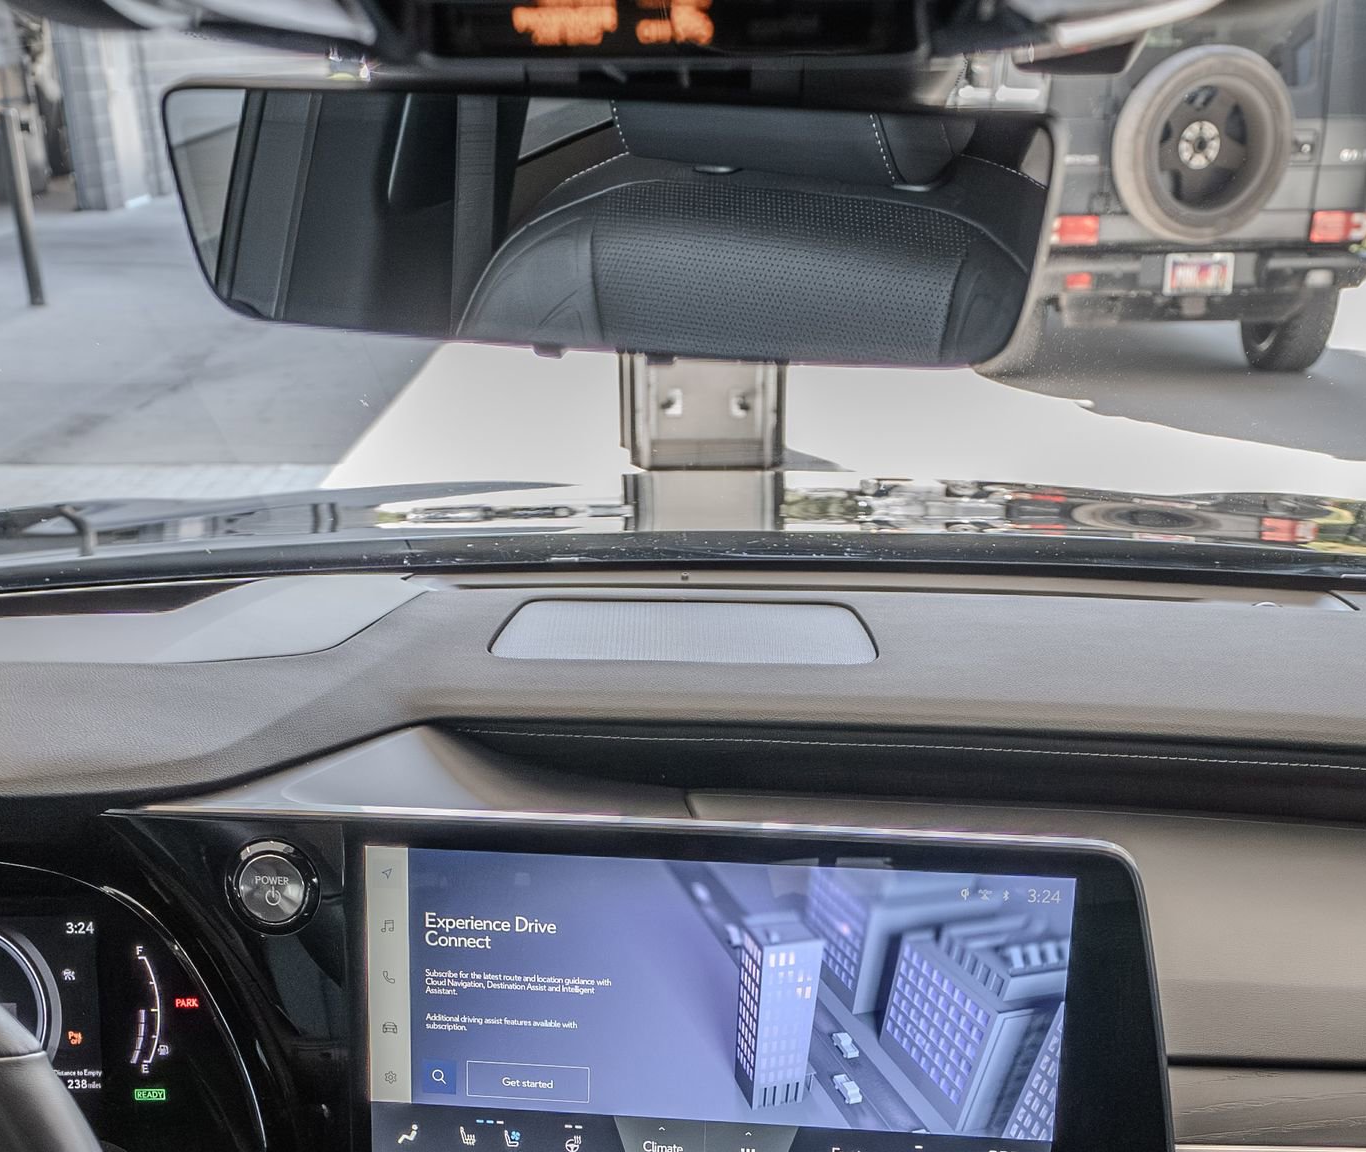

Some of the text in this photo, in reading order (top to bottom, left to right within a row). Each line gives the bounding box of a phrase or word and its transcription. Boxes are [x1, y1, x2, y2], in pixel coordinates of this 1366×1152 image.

[255, 876, 289, 885] POWER
[1027, 889, 1061, 904] 3:24
[425, 912, 557, 934] Experience Drive
[66, 922, 94, 934] 3:24
[425, 930, 491, 949] Connect
[136, 946, 143, 955] F
[425, 968, 458, 978] Subscribe
[459, 971, 470, 979] for
[483, 972, 502, 980] latest
[503, 974, 521, 982] route
[523, 974, 535, 982] and
[537, 975, 563, 983] location
[564, 977, 595, 985] guidance
[596, 978, 612, 986] with
[425, 978, 446, 986] Cloud
[447, 979, 485, 989] Navigation,
[487, 981, 525, 990] Destination
[526, 983, 546, 991] Assist
[562, 985, 595, 995] Intelligent
[425, 986, 458, 995] Assistant.
[176, 999, 199, 1008] PARK
[426, 1013, 459, 1022] Additional
[460, 1015, 482, 1025] driving
[504, 1017, 531, 1026] features
[533, 1019, 561, 1027] available
[426, 1023, 467, 1031] subscription.
[84, 1069, 102, 1077] Empty
[142, 1064, 149, 1073] E
[67, 1080, 87, 1089] 238
[502, 1077, 554, 1089] Get started
[137, 1091, 163, 1099] READY
